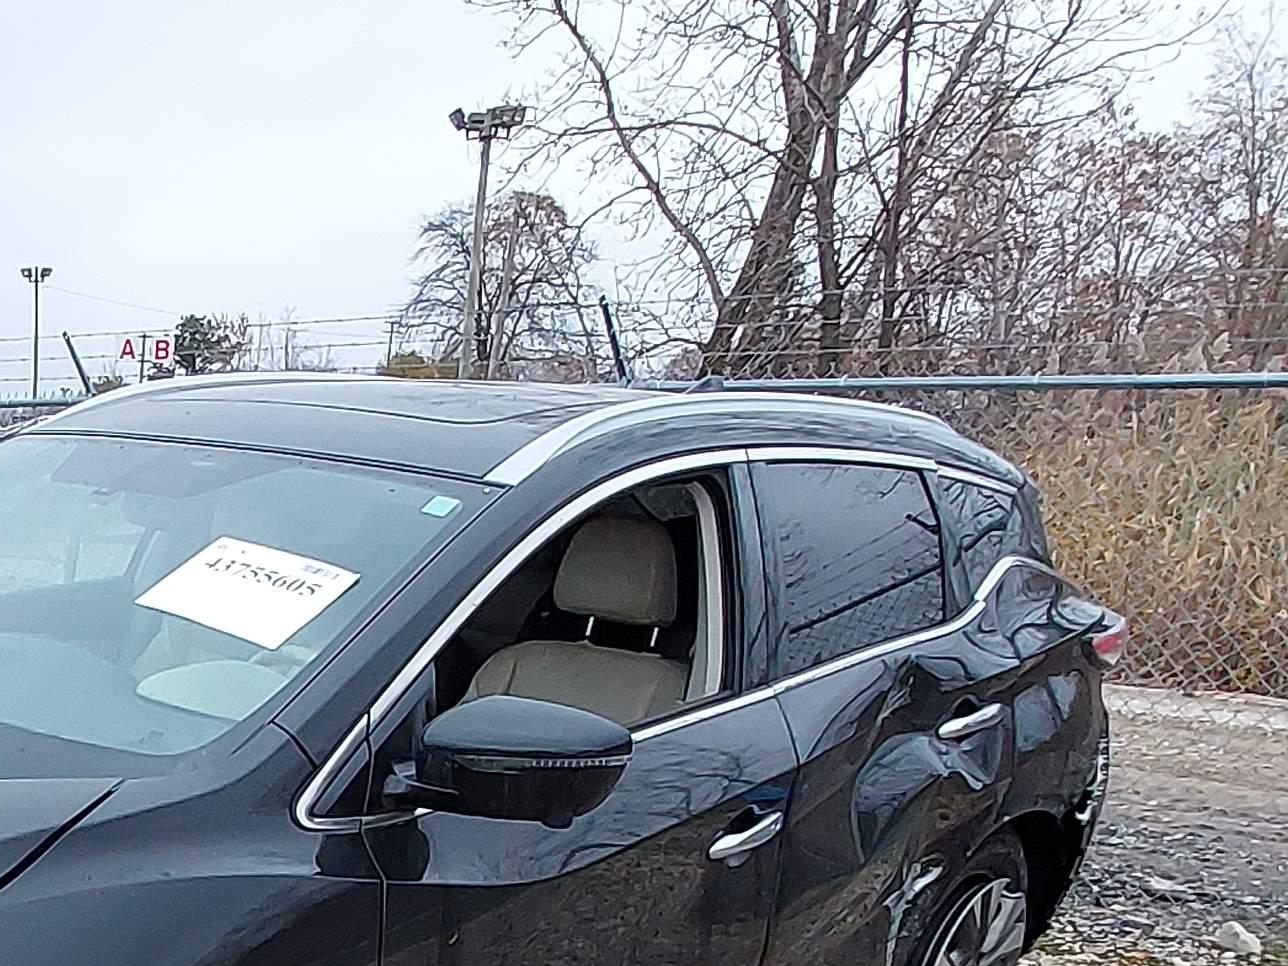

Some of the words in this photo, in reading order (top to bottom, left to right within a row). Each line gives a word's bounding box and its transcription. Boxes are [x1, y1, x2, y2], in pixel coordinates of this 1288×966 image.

[119, 338, 136, 360] A
[154, 339, 170, 360] B
[204, 556, 324, 596] 43755605
